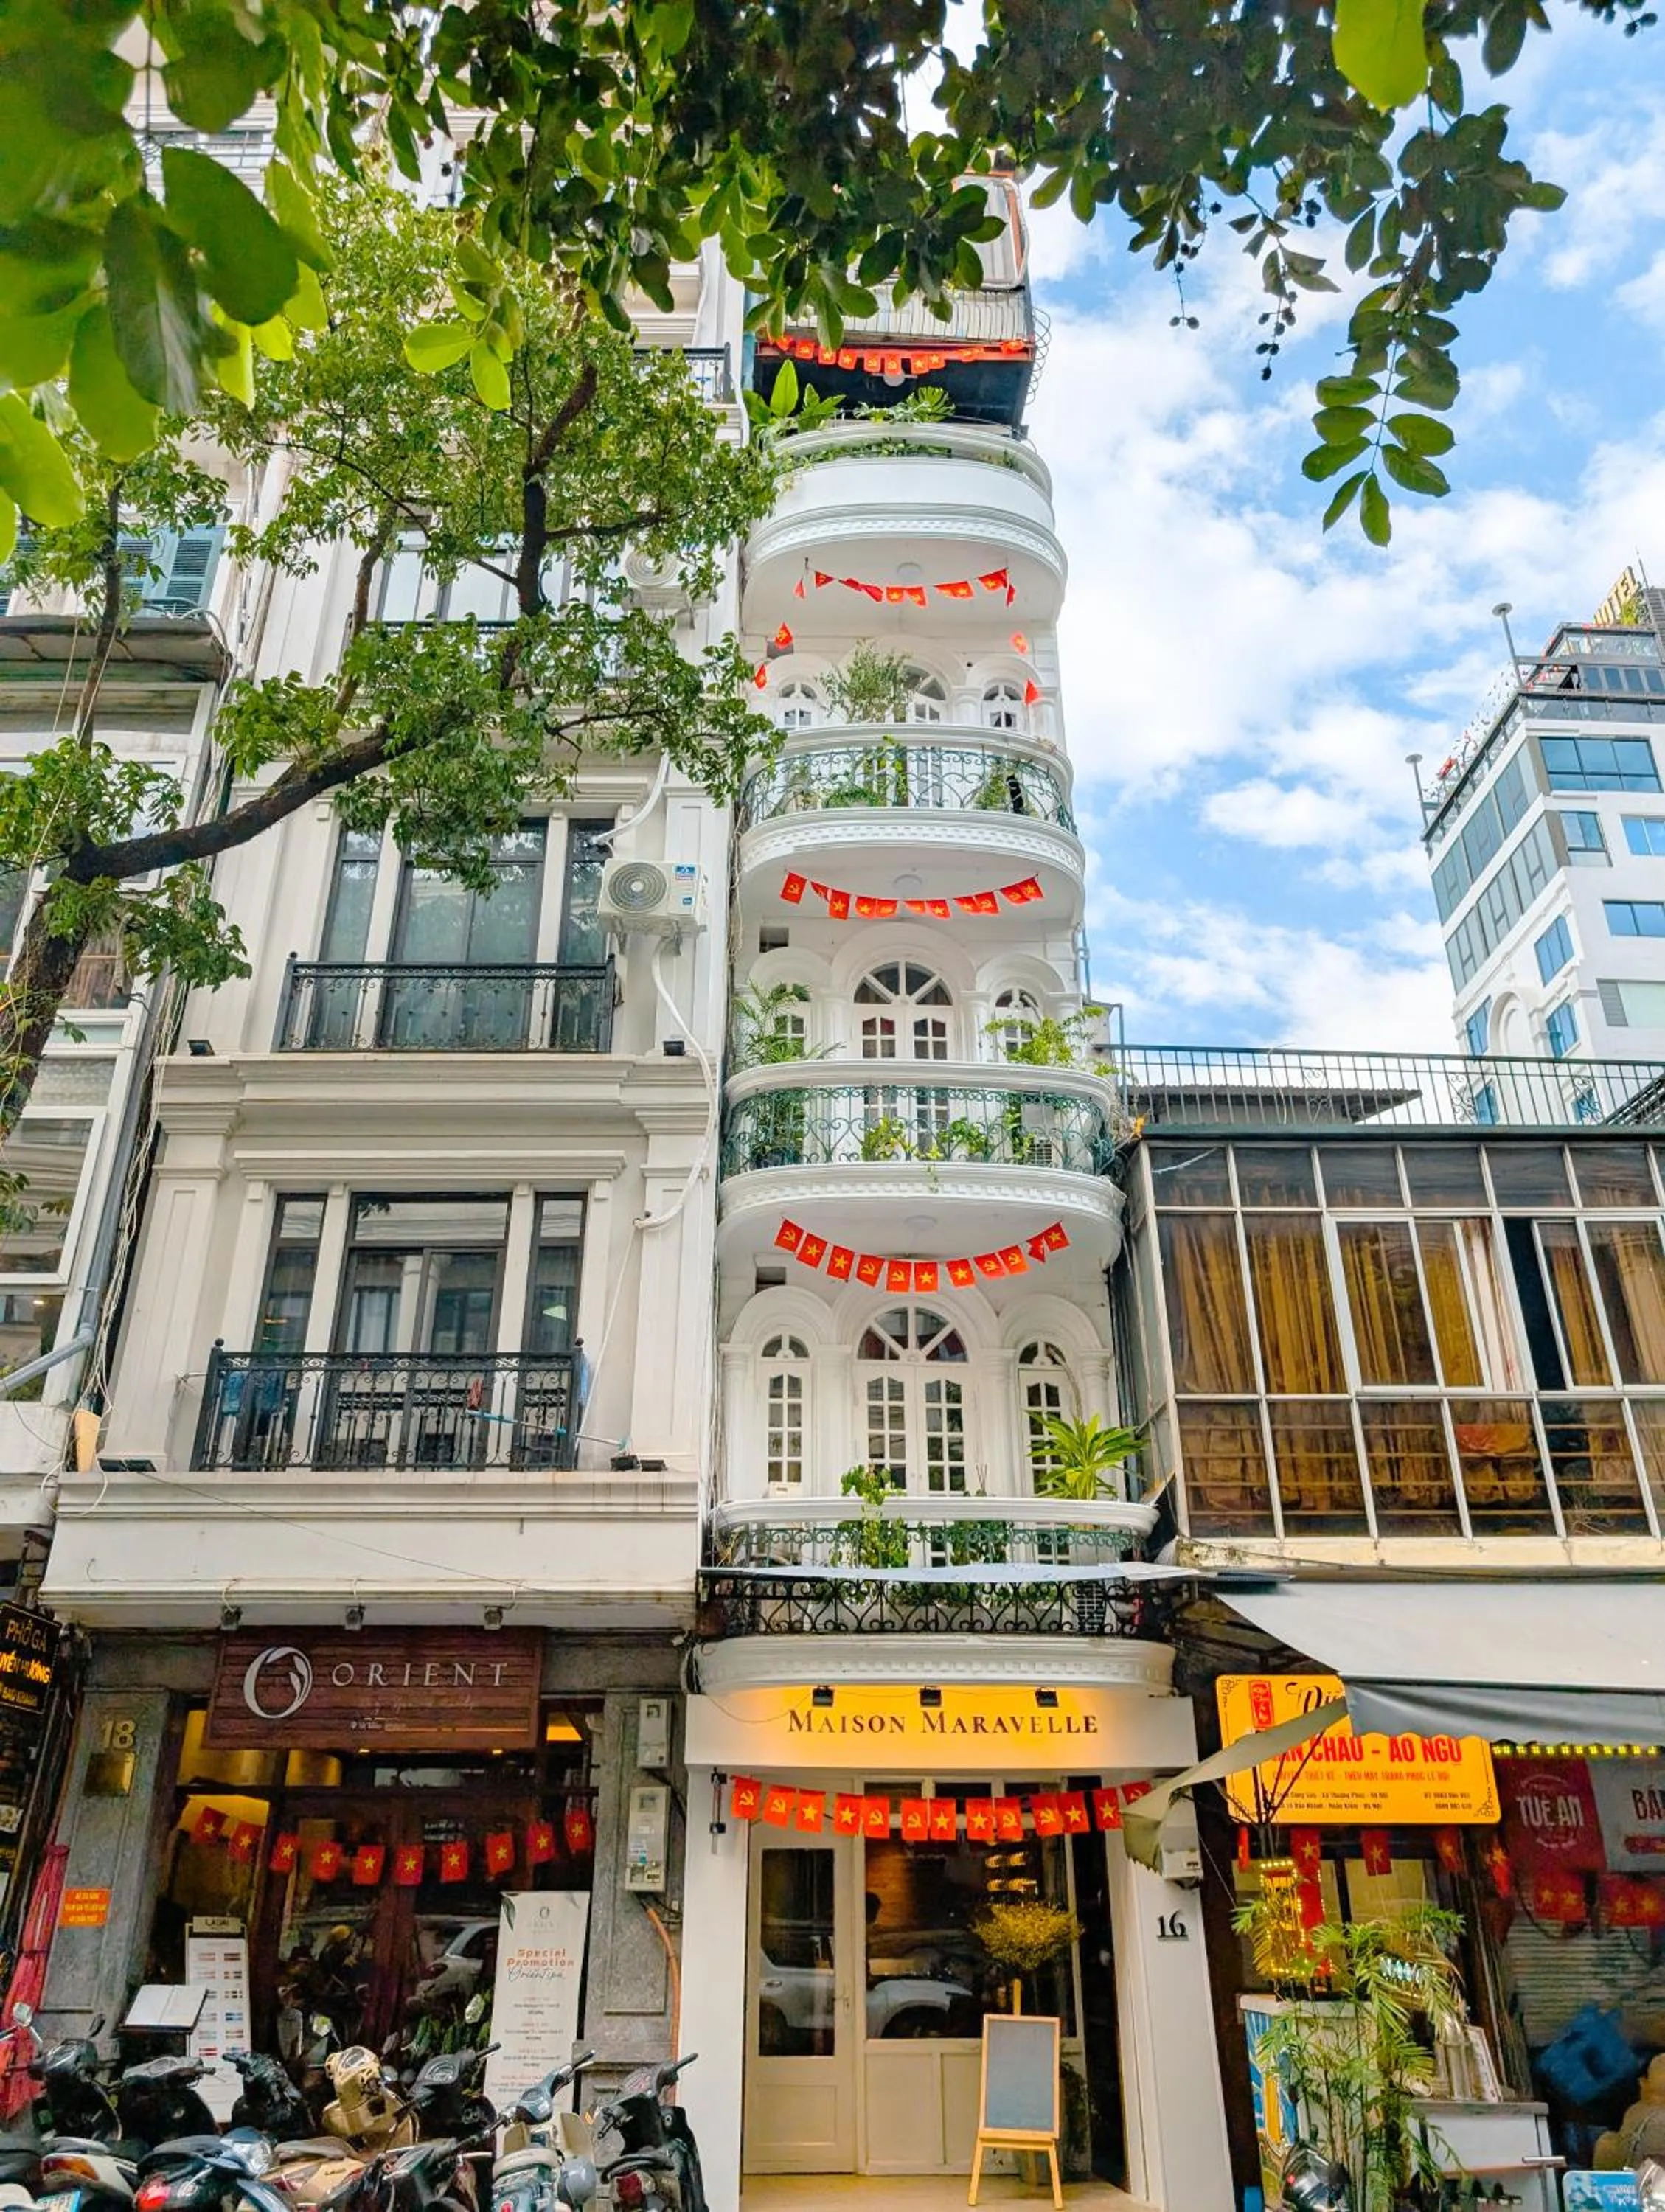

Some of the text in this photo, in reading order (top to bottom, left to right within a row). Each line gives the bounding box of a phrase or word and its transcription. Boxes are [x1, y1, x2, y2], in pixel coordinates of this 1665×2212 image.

[331, 1663, 508, 1686] ORIENT
[102, 1718, 136, 1749] 18
[788, 1710, 1098, 1734] MAISON MARAVELLE
[1631, 1784, 1665, 1820] BÁ
[1158, 1910, 1188, 1938] 16
[507, 1958, 574, 1967] Promotion
[518, 1948, 566, 1958] Special
